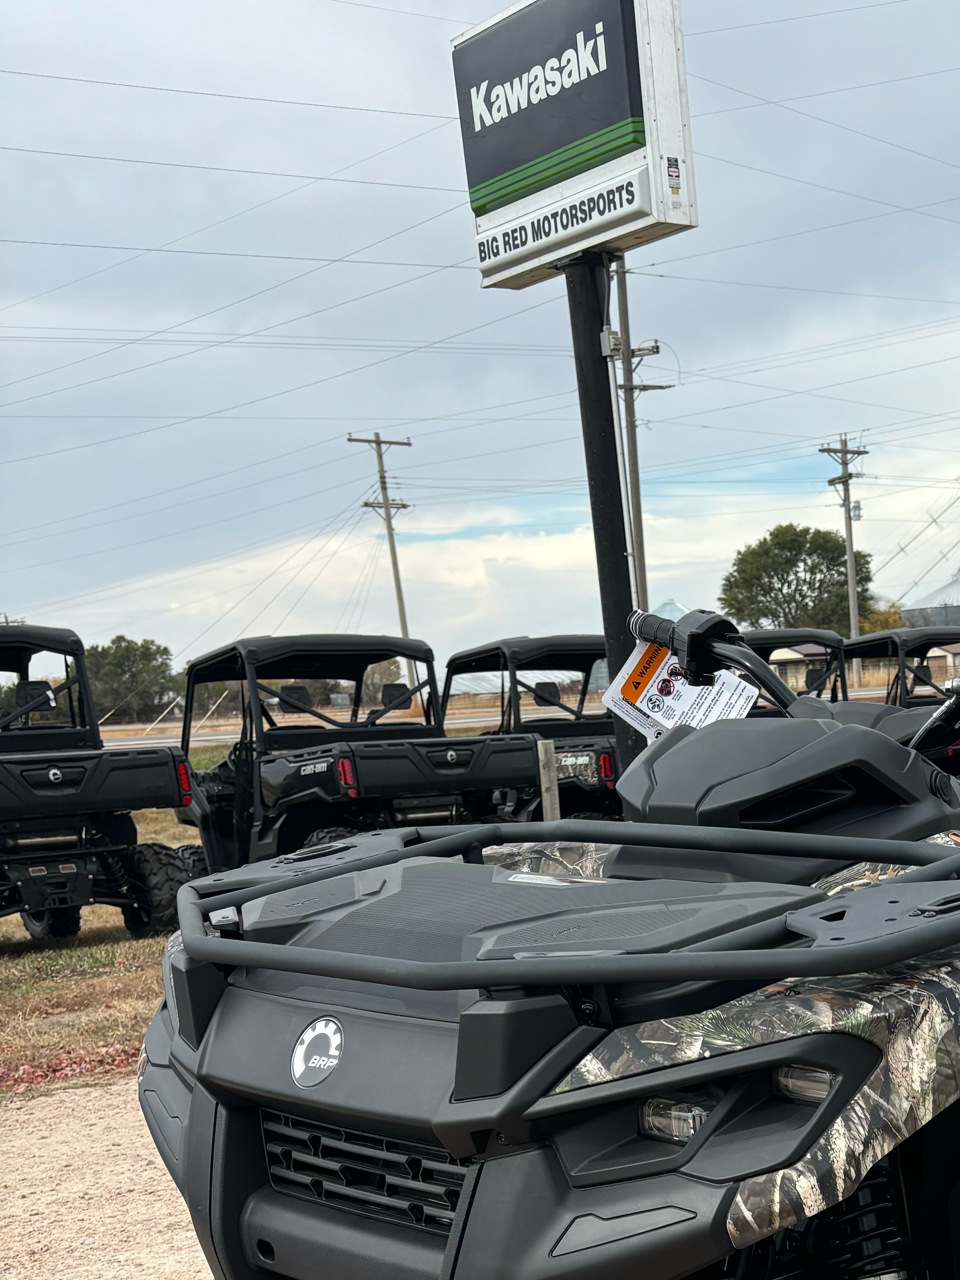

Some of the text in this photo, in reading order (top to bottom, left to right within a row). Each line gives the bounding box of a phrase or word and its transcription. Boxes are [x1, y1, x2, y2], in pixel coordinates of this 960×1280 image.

[470, 21, 608, 133] Kawasaki
[477, 180, 636, 263] BIG RED MOTORSPORTS
[308, 1055, 338, 1070] BRP
